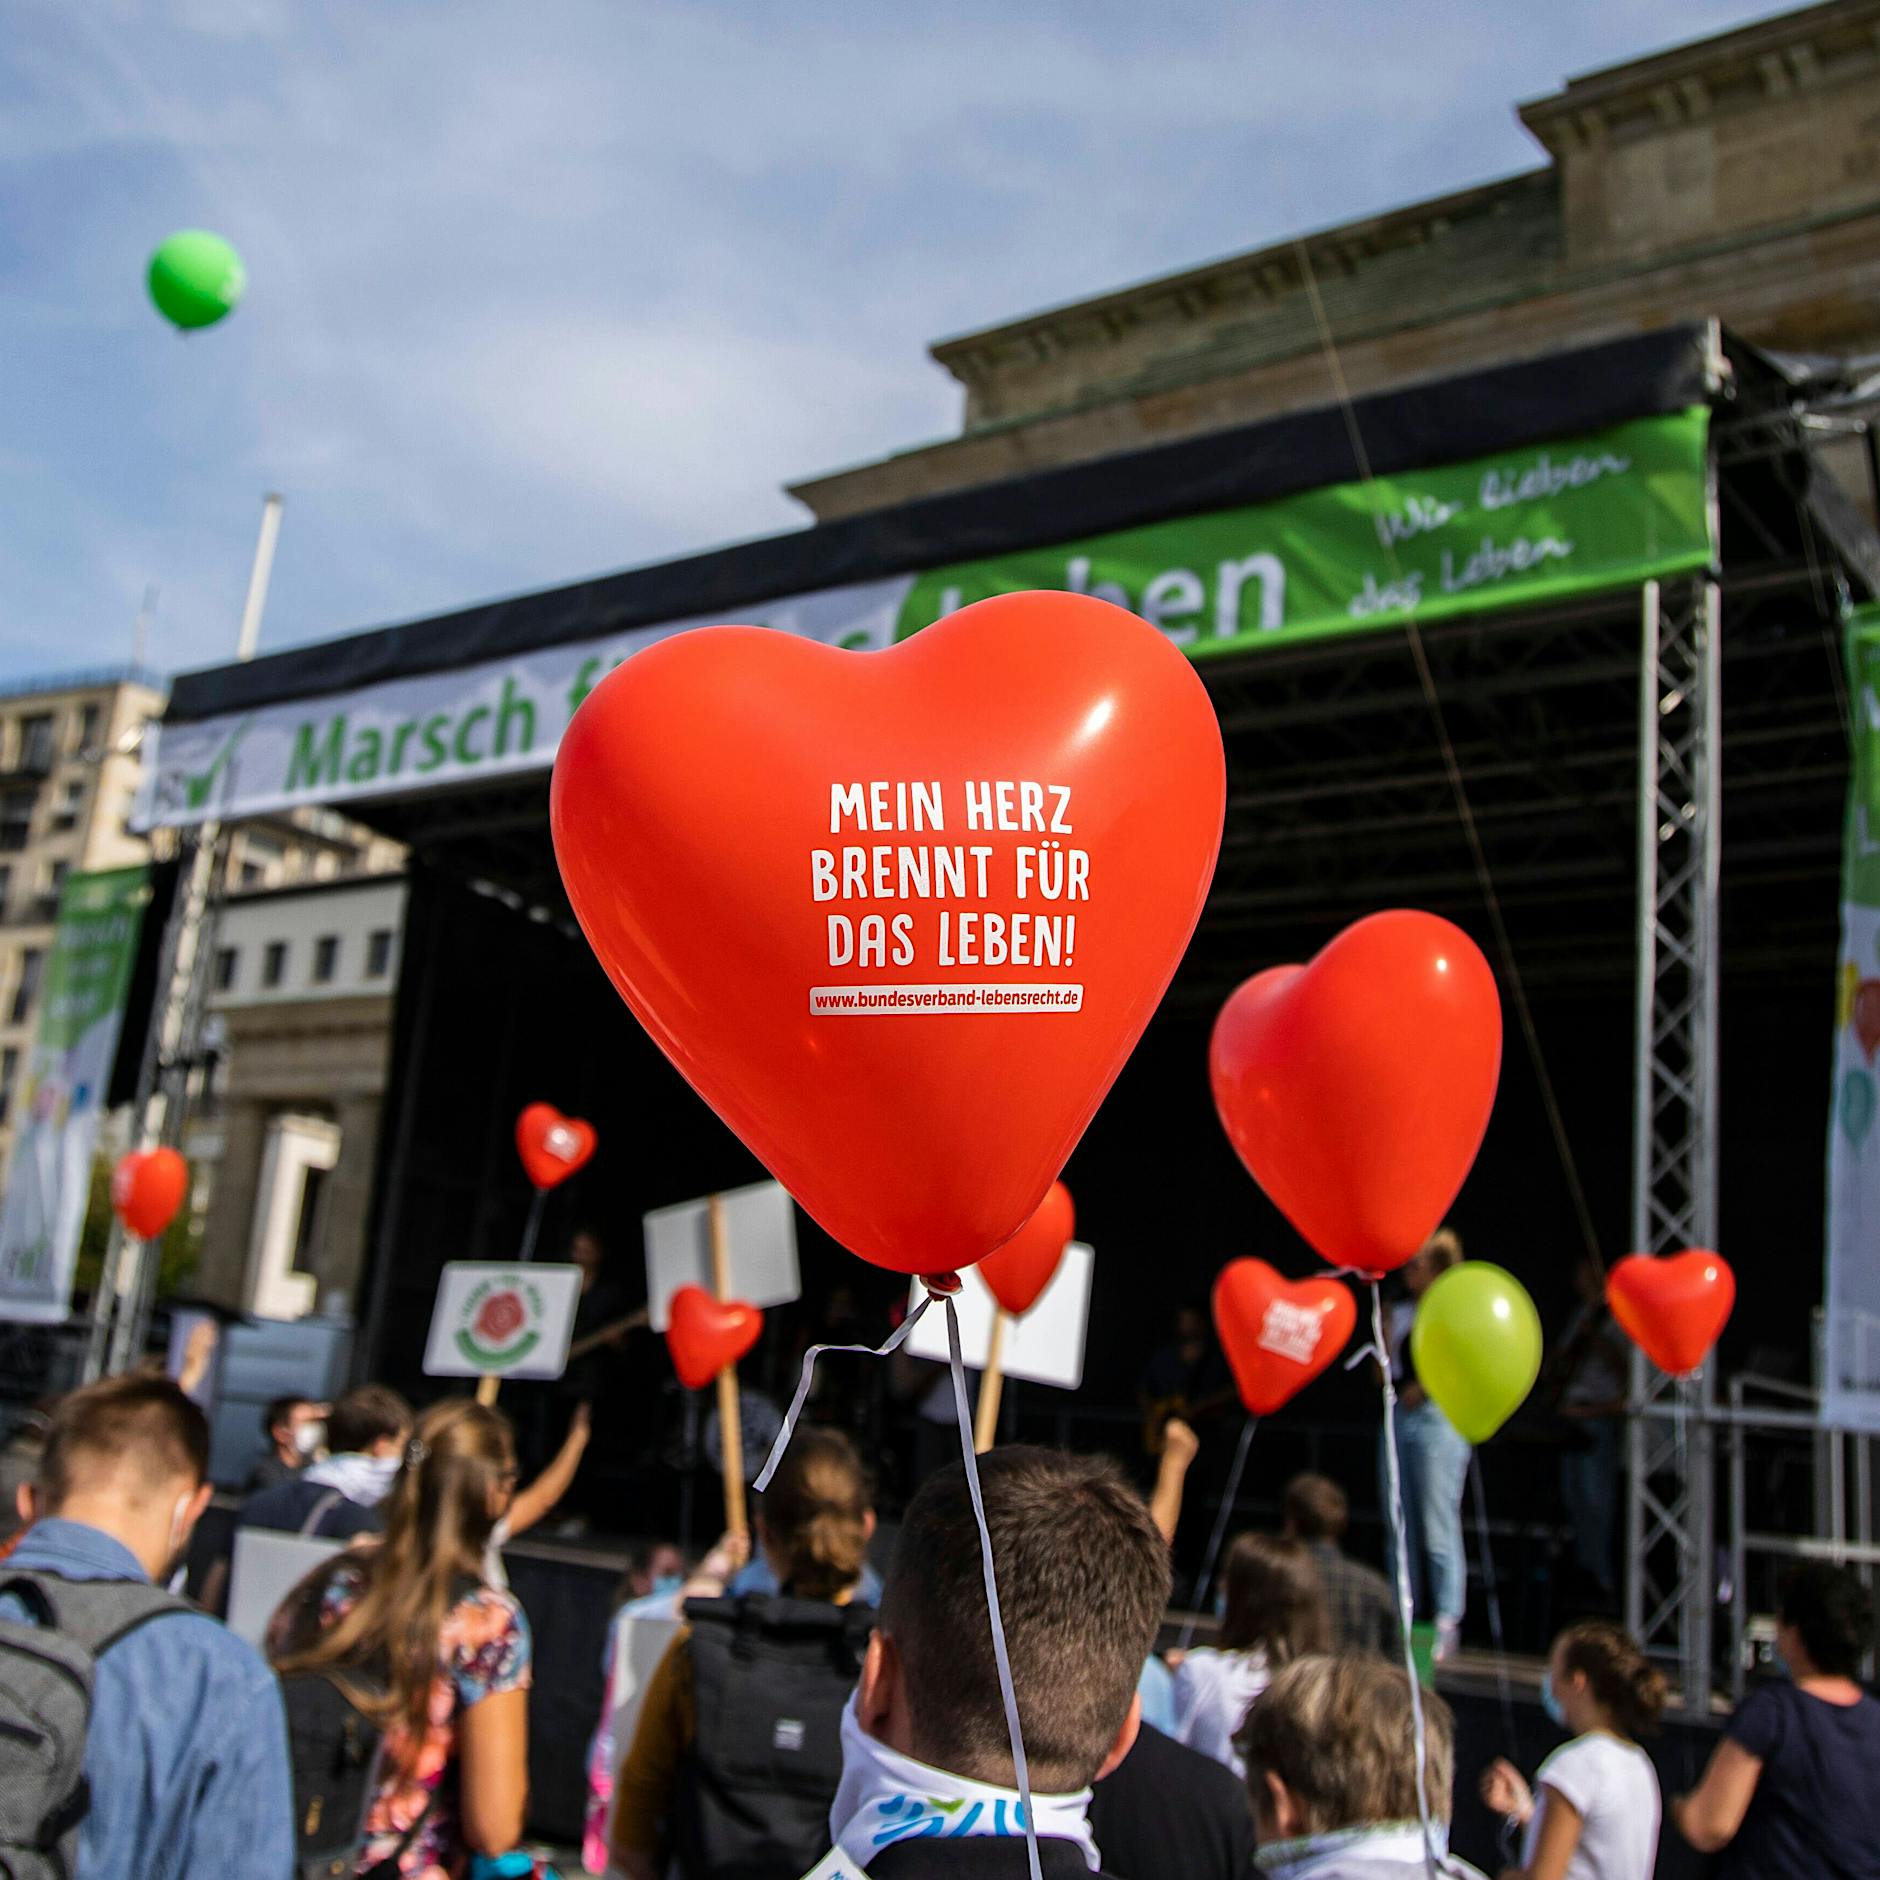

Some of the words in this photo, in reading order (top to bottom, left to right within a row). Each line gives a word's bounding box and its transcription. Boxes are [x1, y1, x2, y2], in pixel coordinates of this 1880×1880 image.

[1440, 537, 1574, 592] Leben
[284, 673, 538, 794] Marsch
[830, 781, 945, 833] MEIN
[965, 781, 1073, 834] HERZ
[811, 846, 993, 901] BRENNT
[1016, 840, 1090, 901] FÜR
[827, 914, 914, 967] DAS
[938, 911, 1076, 967] LEBEN!
[815, 989, 1078, 1009] www.bundesverband-lebensrecht.de
